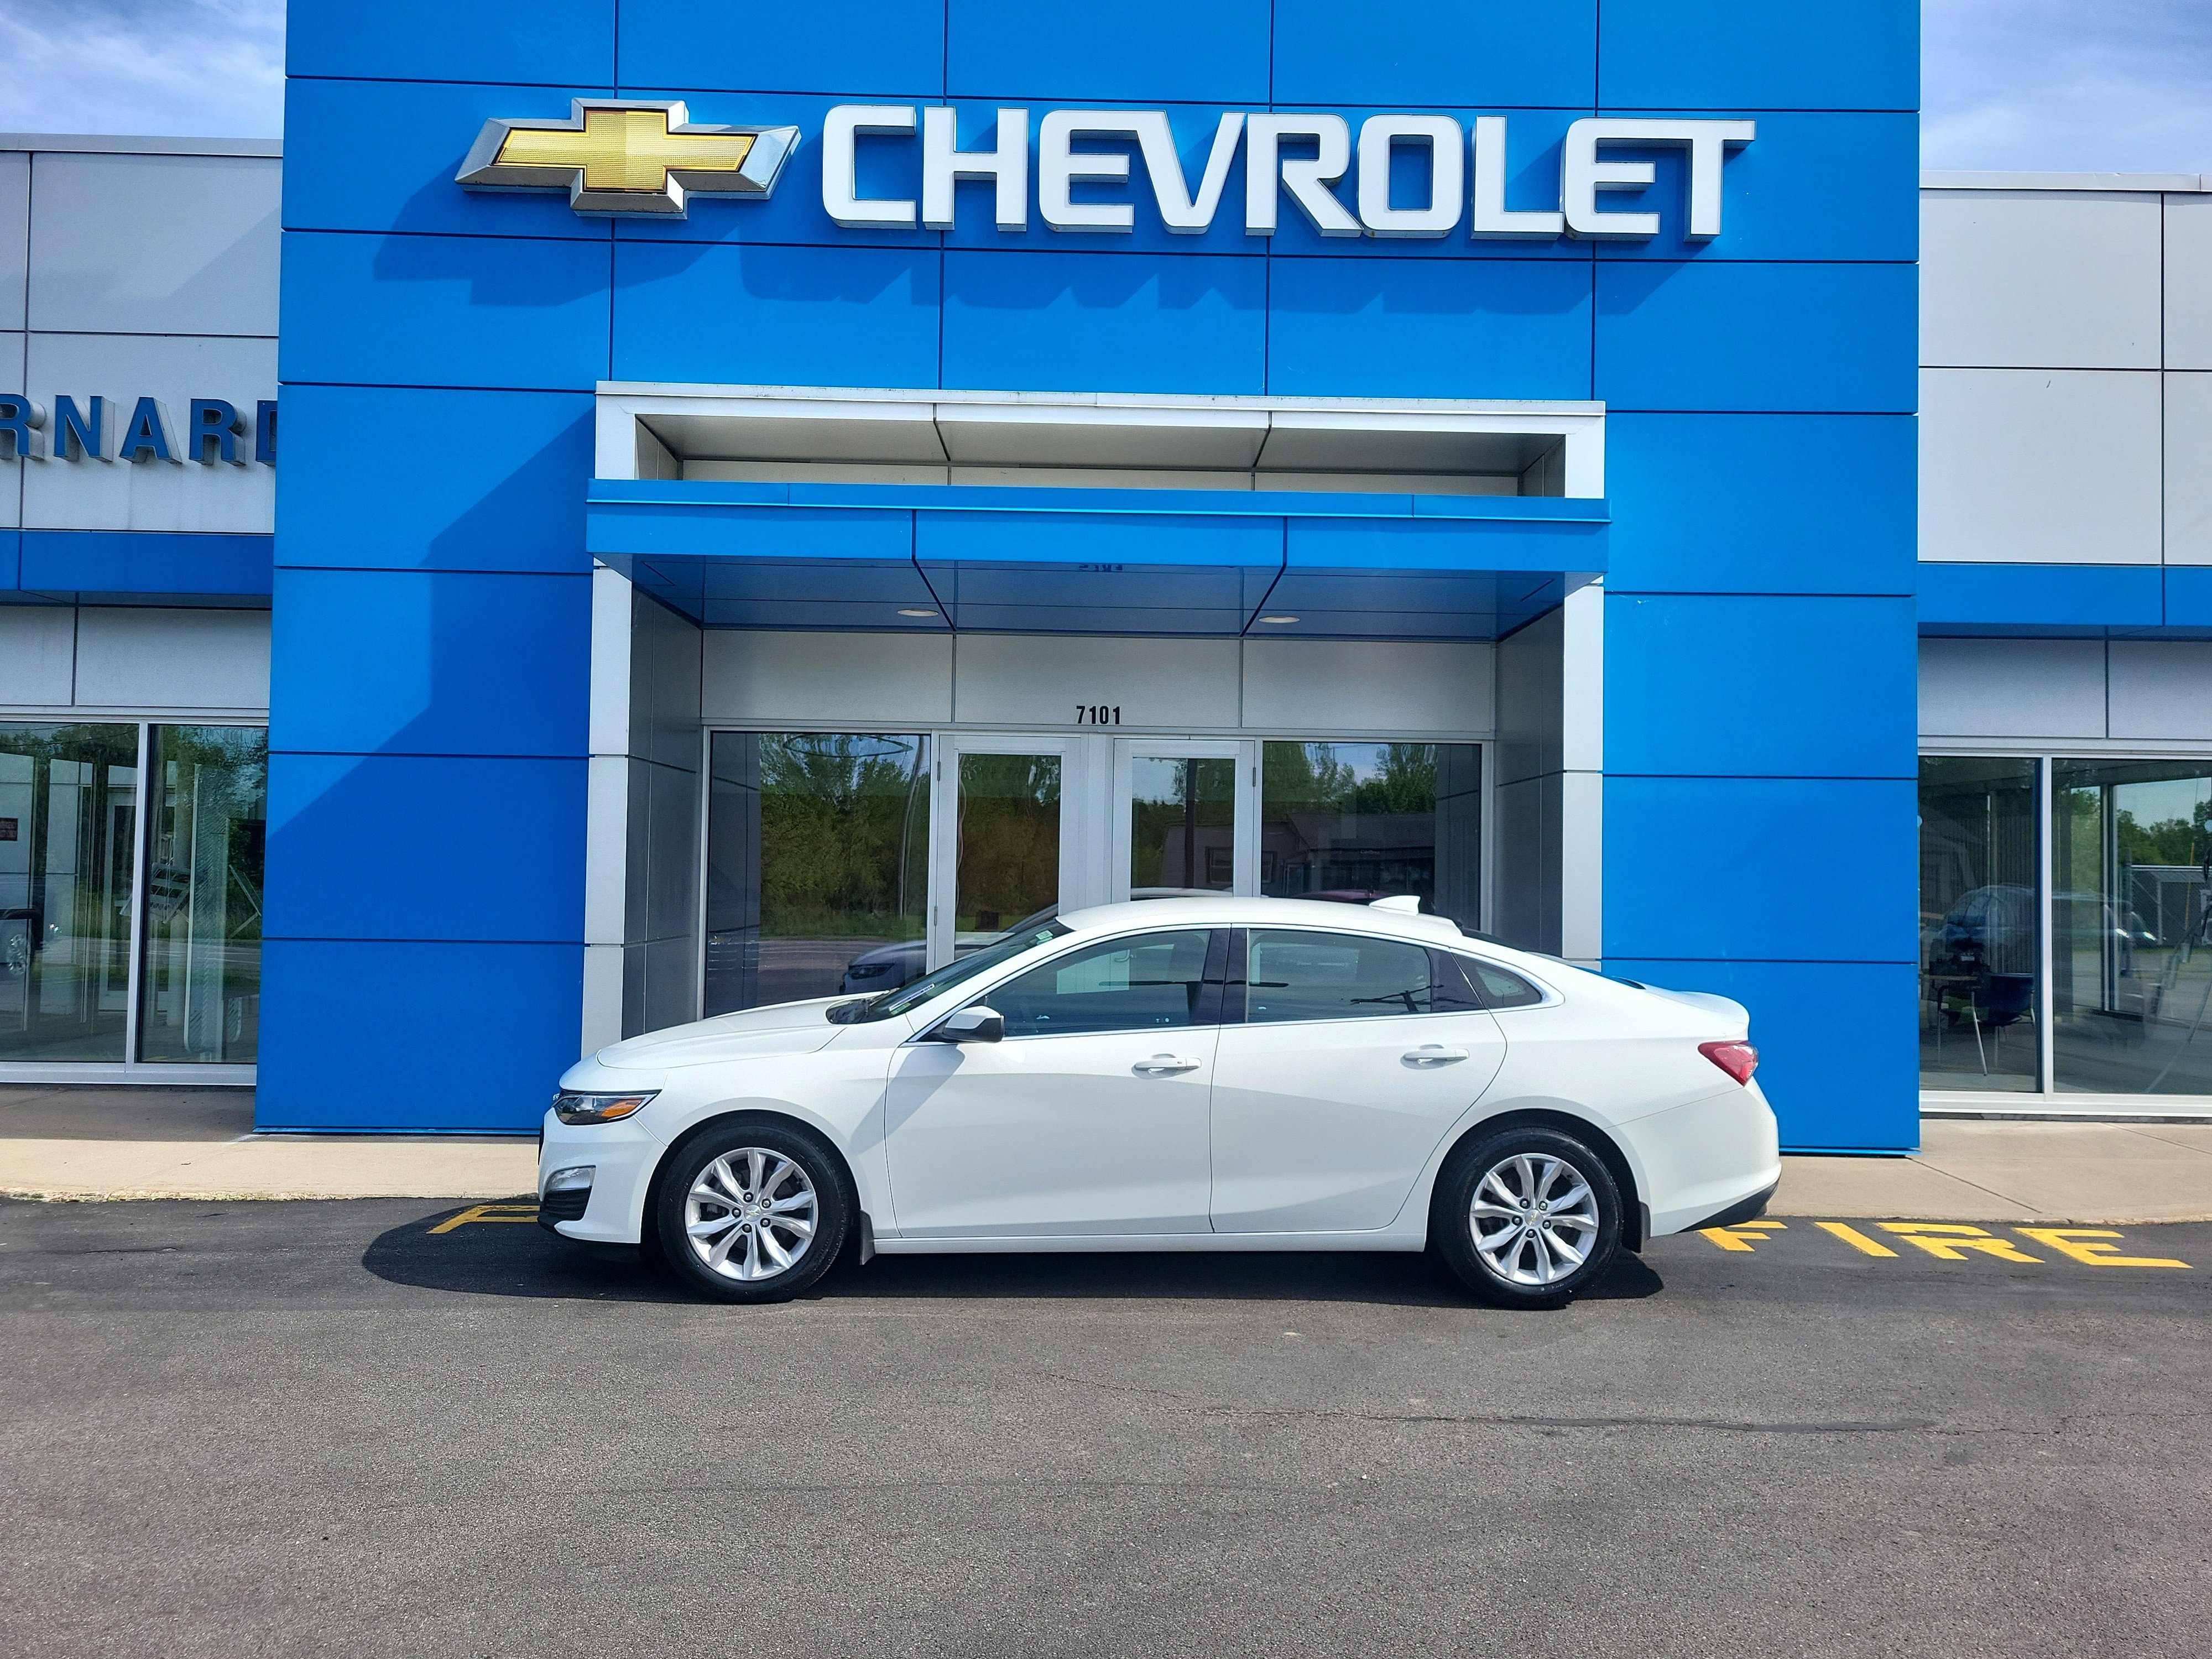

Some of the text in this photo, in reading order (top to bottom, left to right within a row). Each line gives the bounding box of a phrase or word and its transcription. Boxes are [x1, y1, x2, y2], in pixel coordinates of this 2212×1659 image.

[822, 103, 1756, 242] CHEVROLET
[1076, 705, 1120, 725] 7101
[1696, 1220, 2194, 1269] FIRE
